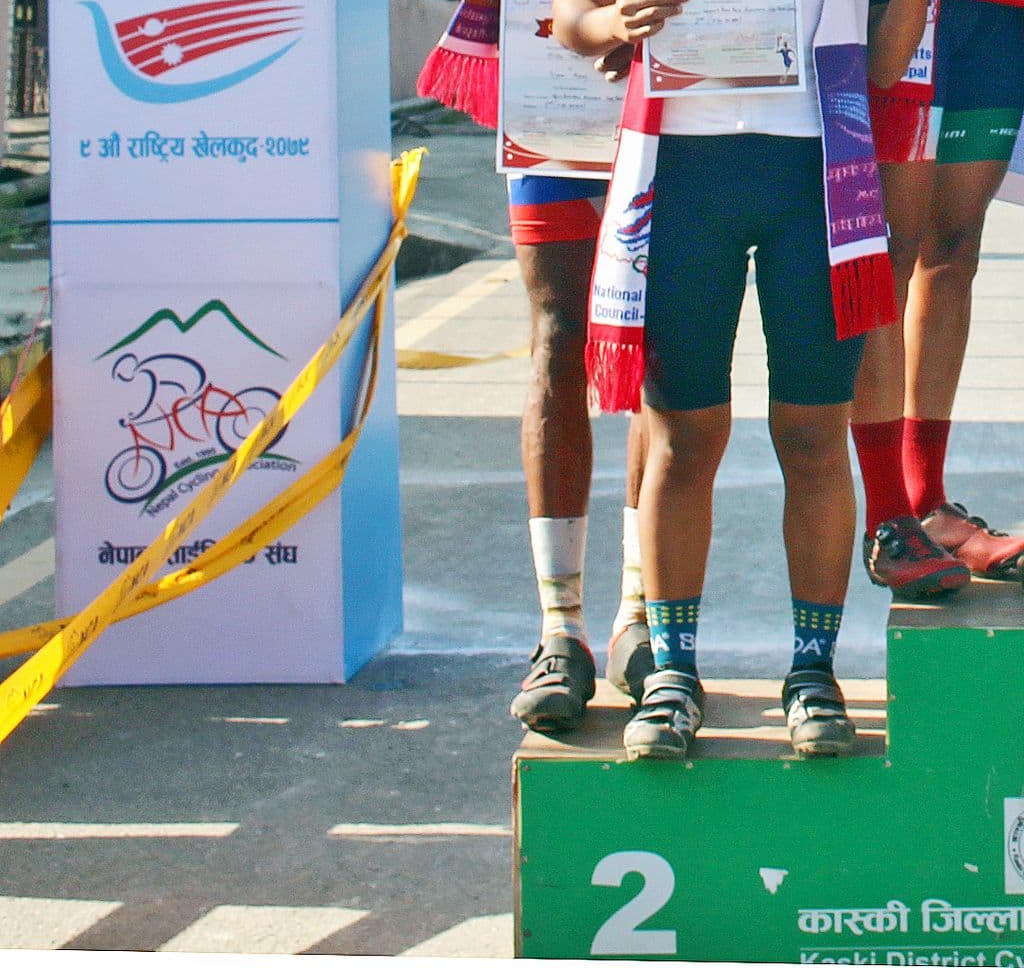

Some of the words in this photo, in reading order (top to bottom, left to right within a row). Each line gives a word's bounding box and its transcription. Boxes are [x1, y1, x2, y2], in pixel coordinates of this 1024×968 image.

[127, 130, 186, 162] राष्ट्रिय
[145, 486, 180, 518] Nepal
[590, 851, 677, 956] 2
[798, 900, 911, 937] कास्की
